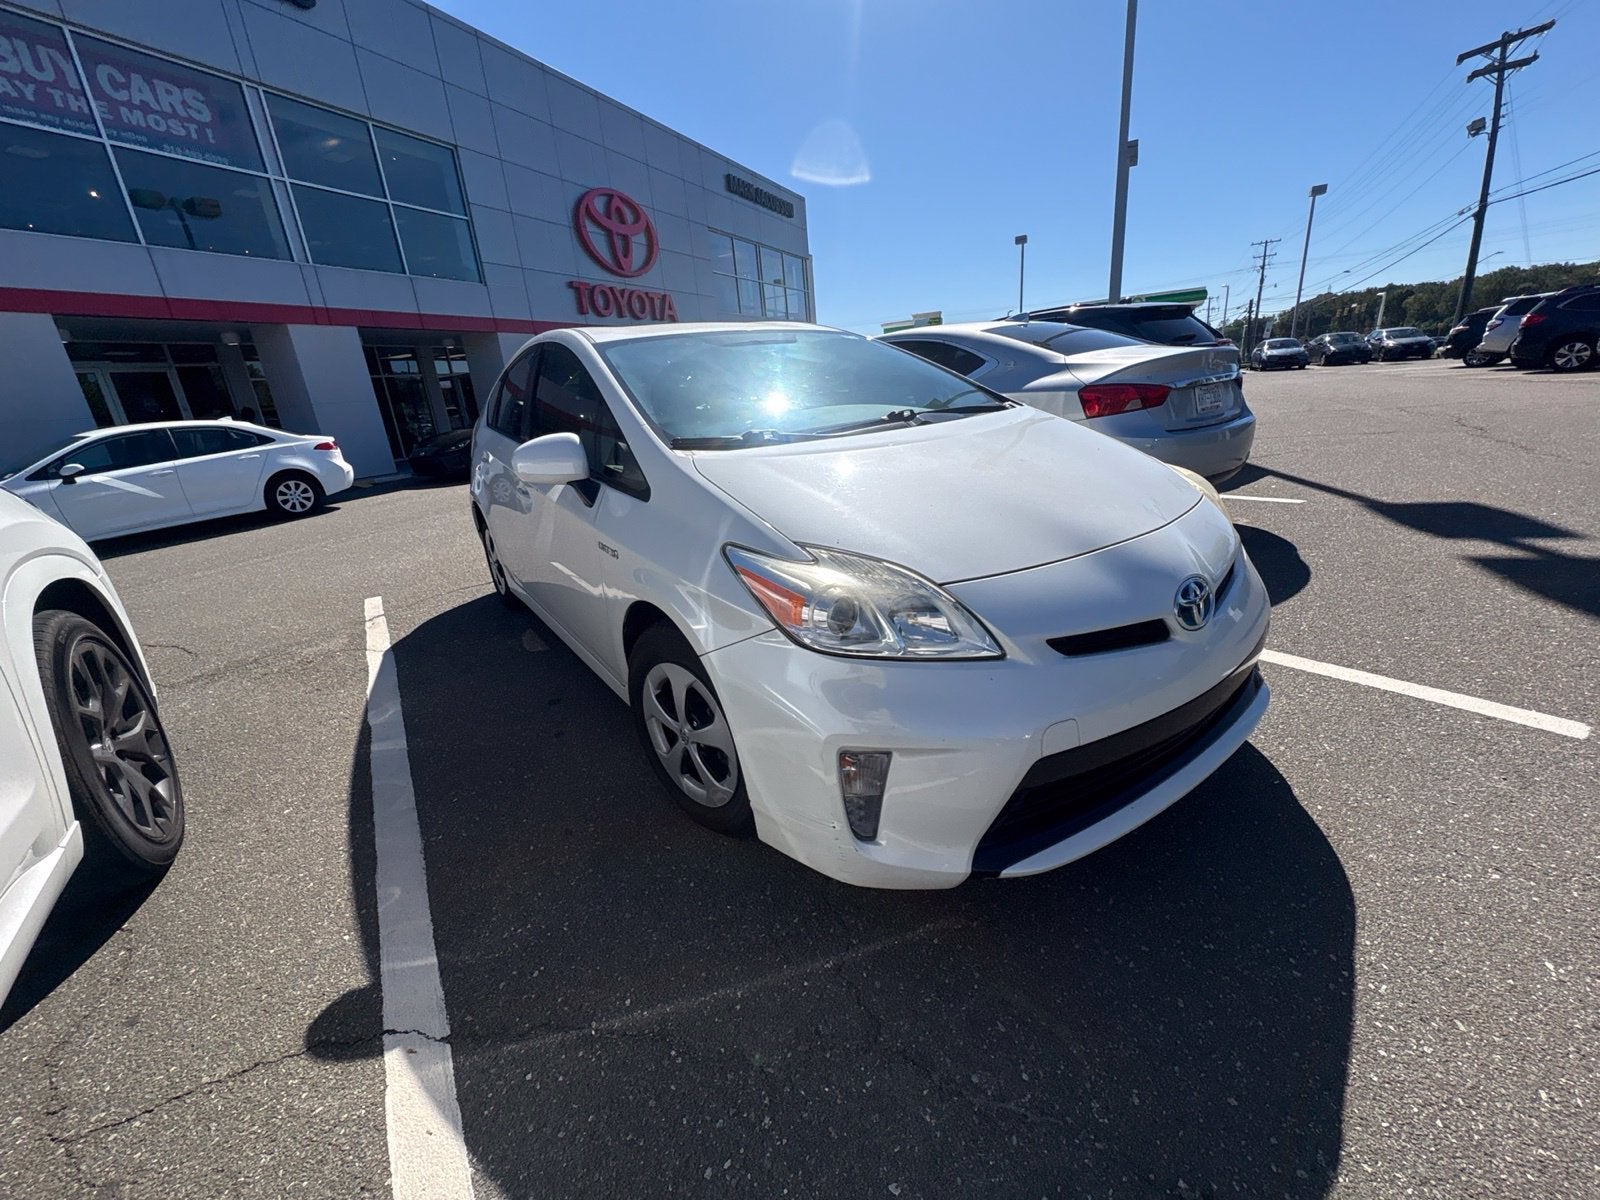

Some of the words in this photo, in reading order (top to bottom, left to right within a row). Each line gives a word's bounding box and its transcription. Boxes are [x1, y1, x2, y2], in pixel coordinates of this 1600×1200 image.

[0, 35, 81, 90] BUY
[95, 63, 213, 123] CARS
[46, 87, 114, 120] THE
[567, 281, 679, 323] TOYOTA
